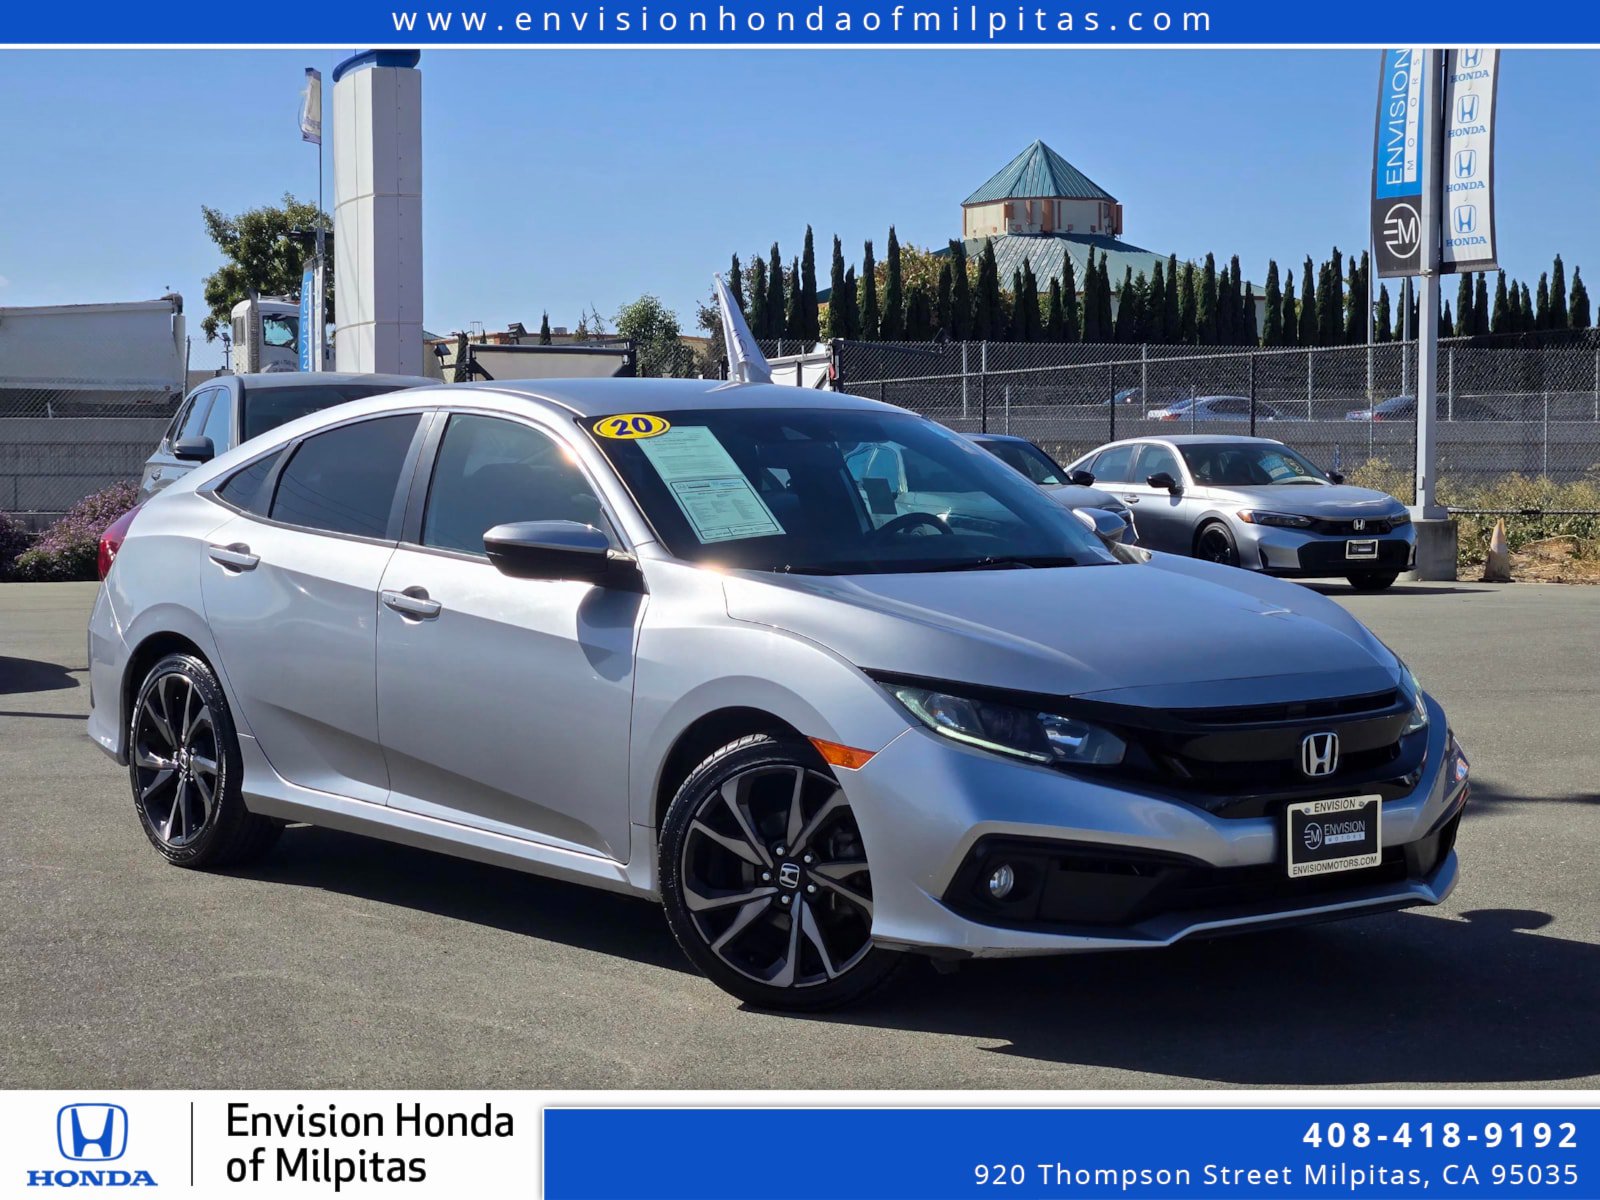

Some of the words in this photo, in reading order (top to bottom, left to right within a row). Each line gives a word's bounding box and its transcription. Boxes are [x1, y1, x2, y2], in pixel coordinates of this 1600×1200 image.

[1450, 69, 1490, 84] HONDA
[1386, 49, 1410, 185] ENVISION
[1407, 58, 1420, 171] MOTORS
[1447, 125, 1487, 138] HONDA
[1445, 180, 1485, 193] HONDA
[1446, 235, 1487, 247] HONDA
[611, 417, 653, 436] 20
[1314, 798, 1356, 813] ENVISION
[1324, 820, 1366, 836] ENVISION
[1292, 856, 1377, 875] ENVISIONMOTORS.COM
